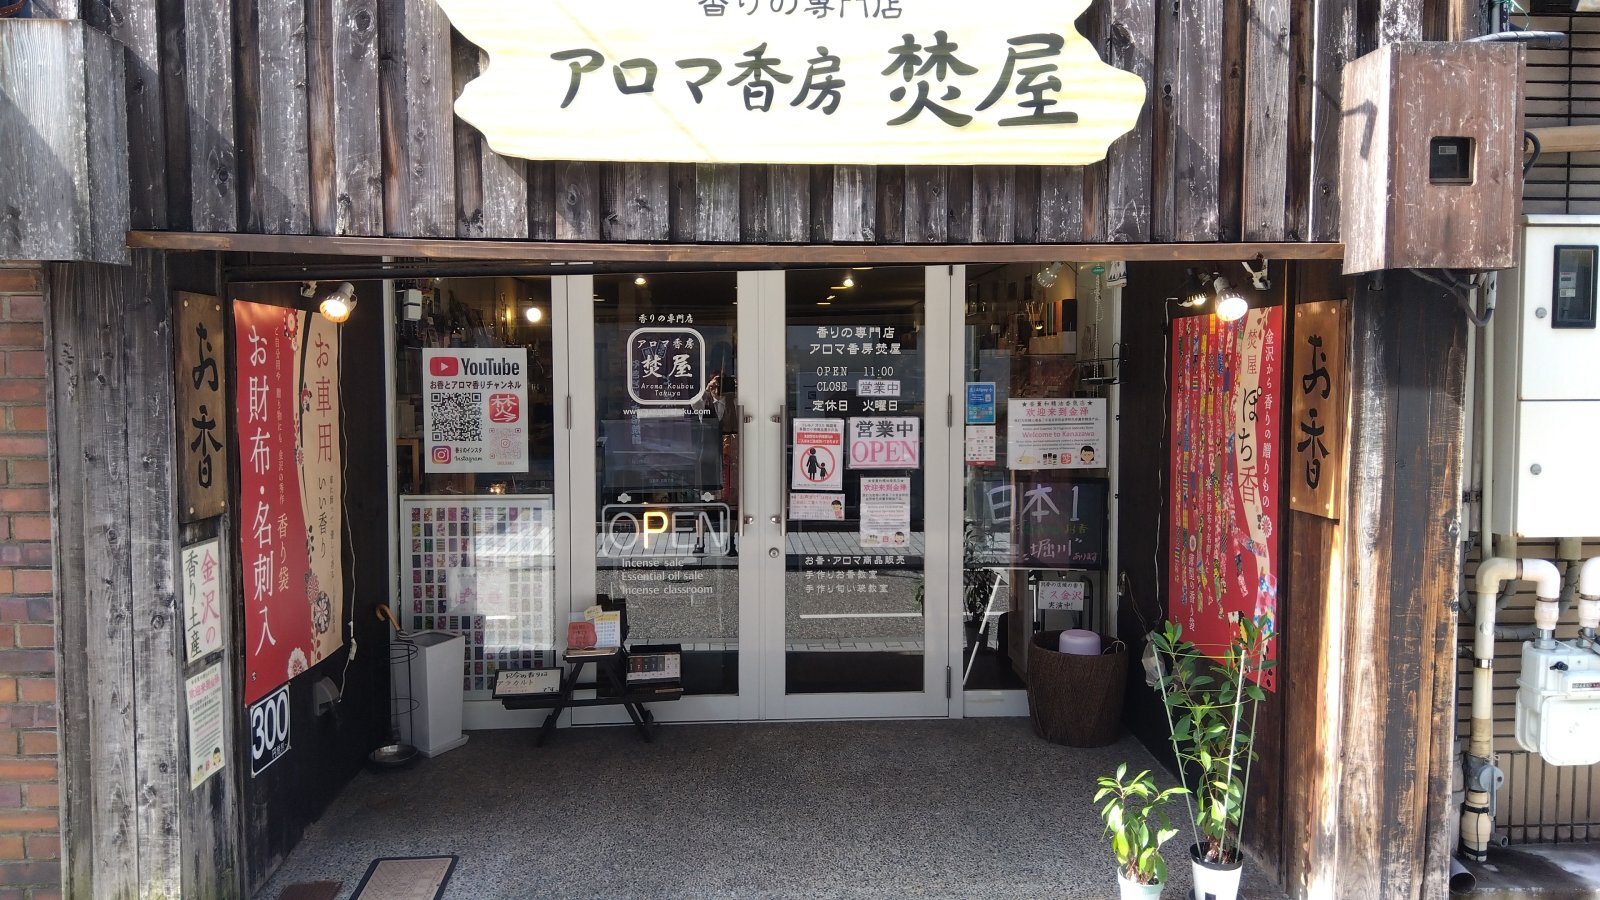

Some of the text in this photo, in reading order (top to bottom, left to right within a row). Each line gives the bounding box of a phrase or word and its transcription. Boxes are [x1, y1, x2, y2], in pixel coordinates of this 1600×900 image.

[550, 29, 1079, 128] アロマ香房 焚屋
[639, 314, 693, 324] 香りの専門店
[816, 326, 895, 339] 香りの専門店
[638, 338, 694, 349] アロマ香房
[809, 343, 901, 355] アロマ香房焚屋
[1247, 329, 1257, 375] 焚屋
[461, 357, 520, 376] YouTube
[641, 354, 693, 378] 焚屋
[816, 366, 894, 377] OPEN 11:00
[430, 381, 522, 390] お香とアロマ香りチャンネル
[816, 381, 848, 392] CLOSE
[860, 381, 899, 394] 営業中
[191, 322, 223, 488] お香
[315, 332, 332, 464] お車用
[812, 400, 898, 412] 定休日 火曜日
[1261, 330, 1275, 508] 金沢から香りの贈りもの
[1297, 334, 1330, 490] お香
[855, 420, 914, 438] 営業中
[1062, 430, 1095, 438] Kanazawa
[851, 440, 917, 463] OPEN
[1238, 387, 1262, 505] ぽち香
[249, 325, 276, 656] お財布・名刺入
[609, 511, 724, 550] OPEN
[277, 512, 289, 592] 香り袋
[804, 555, 906, 565] お香・アロマ商品販売
[622, 558, 684, 568] Incense sale
[621, 571, 703, 581] Essential oil sale
[804, 570, 878, 580] 手作りお香教室
[201, 549, 220, 643] 金沢の
[621, 585, 713, 594] Incense classroom
[185, 550, 202, 657] 香り土産
[253, 691, 288, 760] 300
